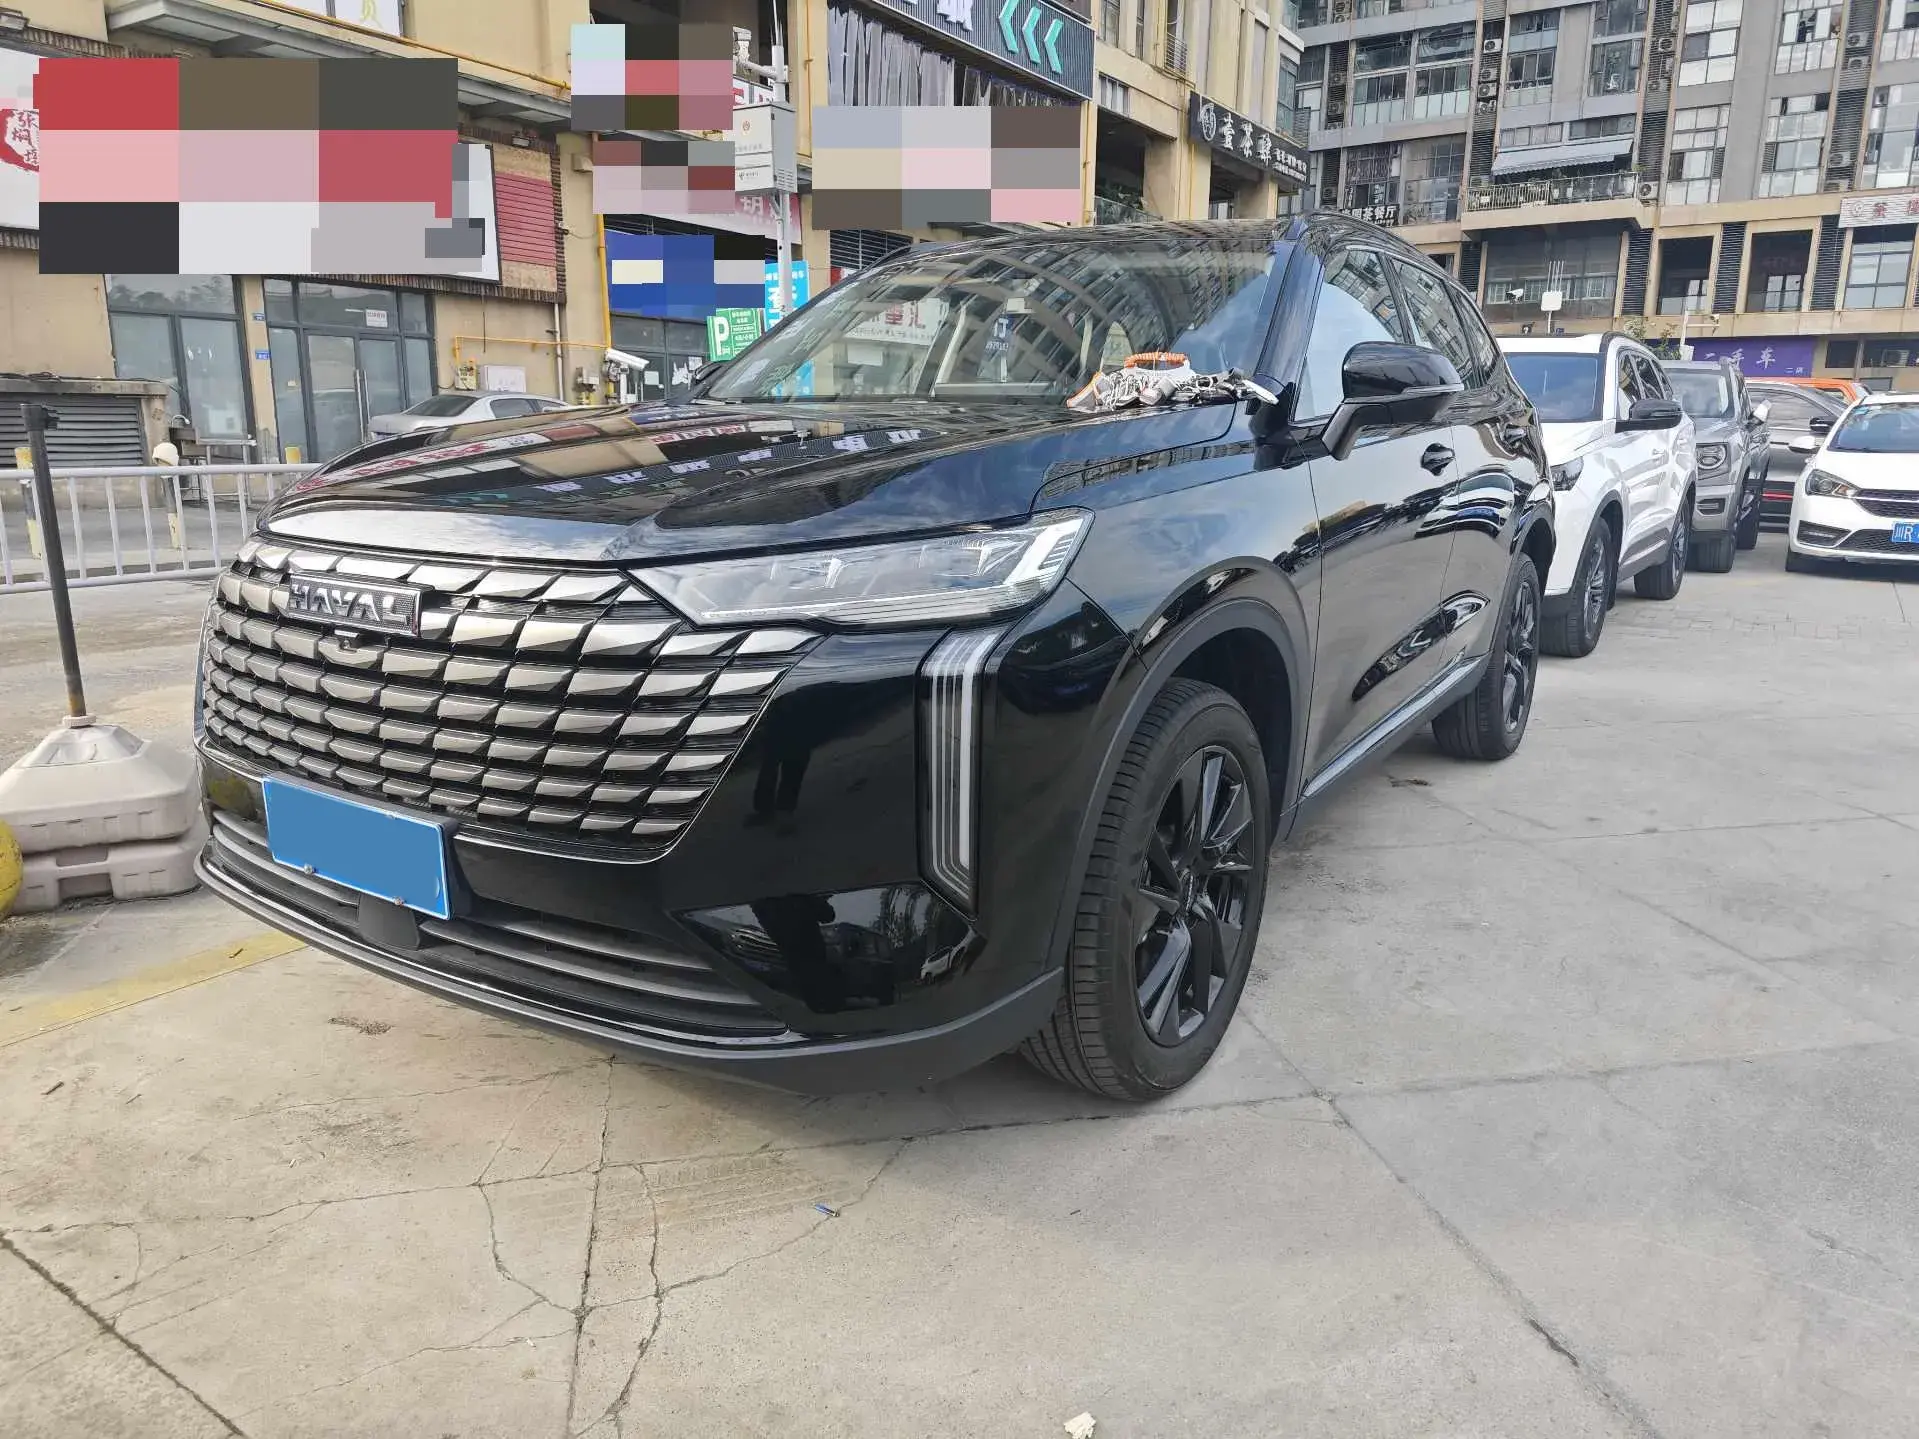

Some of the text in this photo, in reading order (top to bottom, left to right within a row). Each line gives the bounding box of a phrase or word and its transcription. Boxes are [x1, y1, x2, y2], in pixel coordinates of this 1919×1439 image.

[713, 316, 730, 356] P
[1894, 525, 1919, 541] 川R
[290, 583, 408, 625] HAVAL
